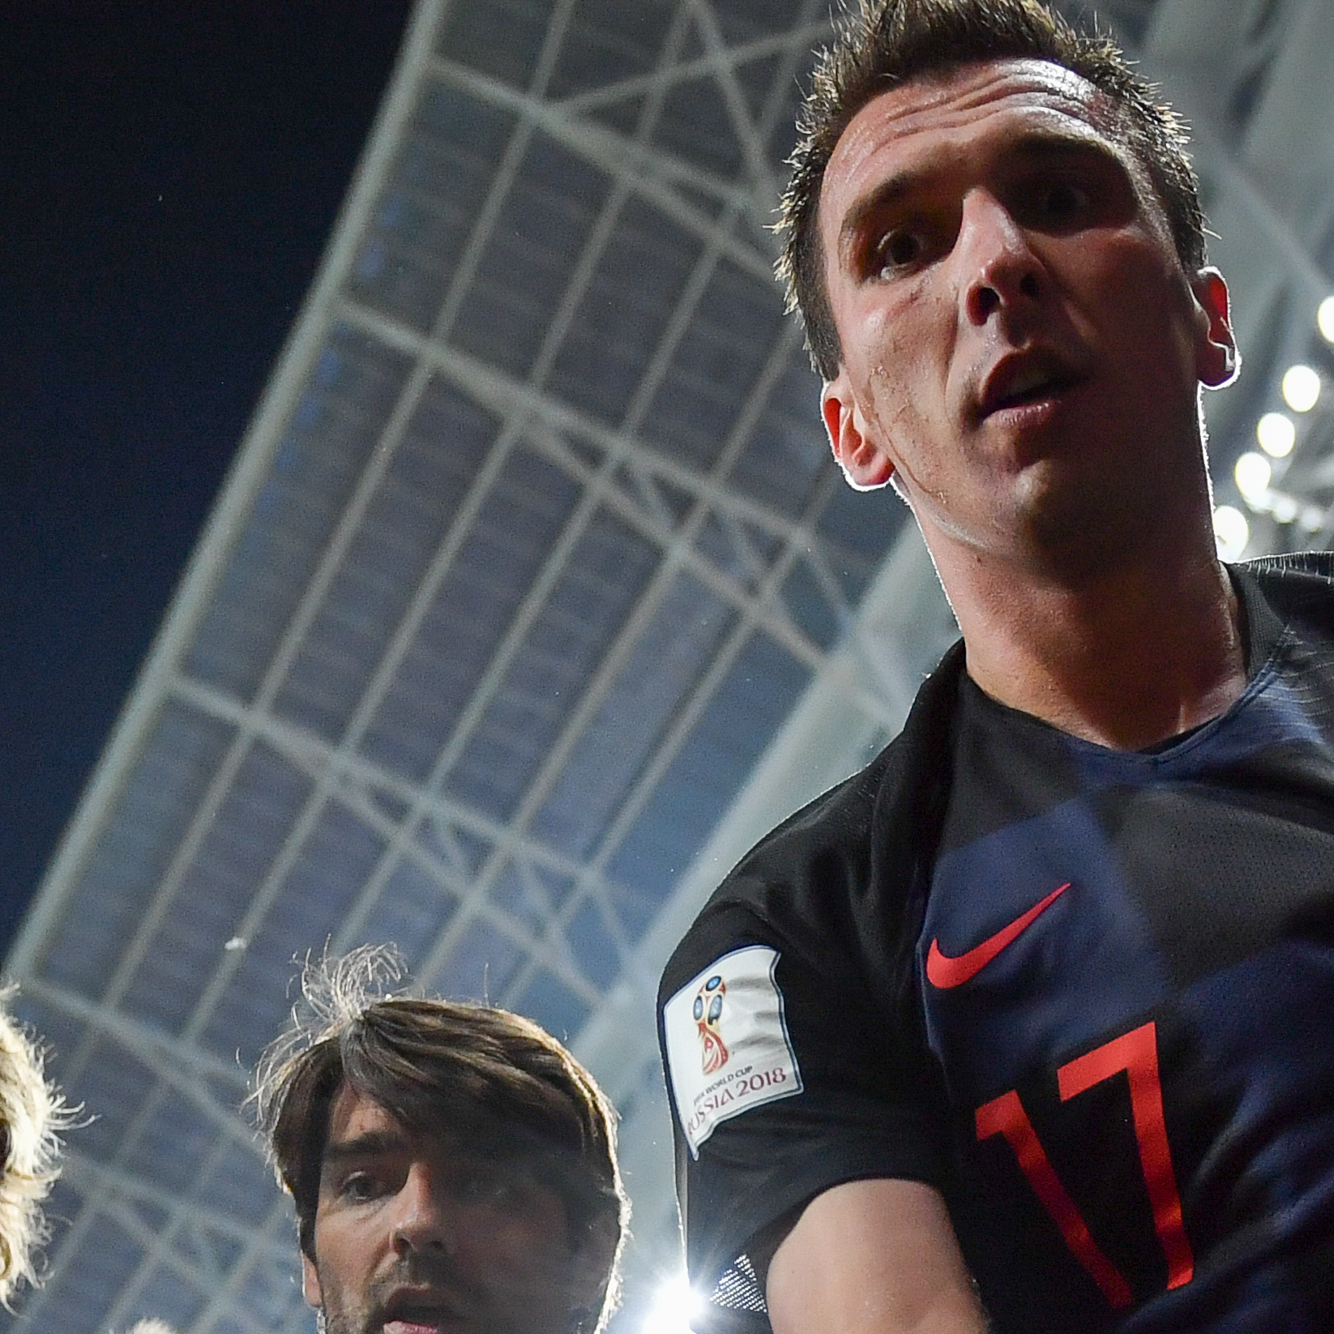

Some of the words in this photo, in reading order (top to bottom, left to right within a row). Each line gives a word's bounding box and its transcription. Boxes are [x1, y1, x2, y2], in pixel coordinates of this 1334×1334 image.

[705, 1073, 735, 1094] WORLD
[735, 1065, 753, 1079] CUP
[736, 1067, 786, 1098] 2018
[974, 1021, 1194, 1311] 17
